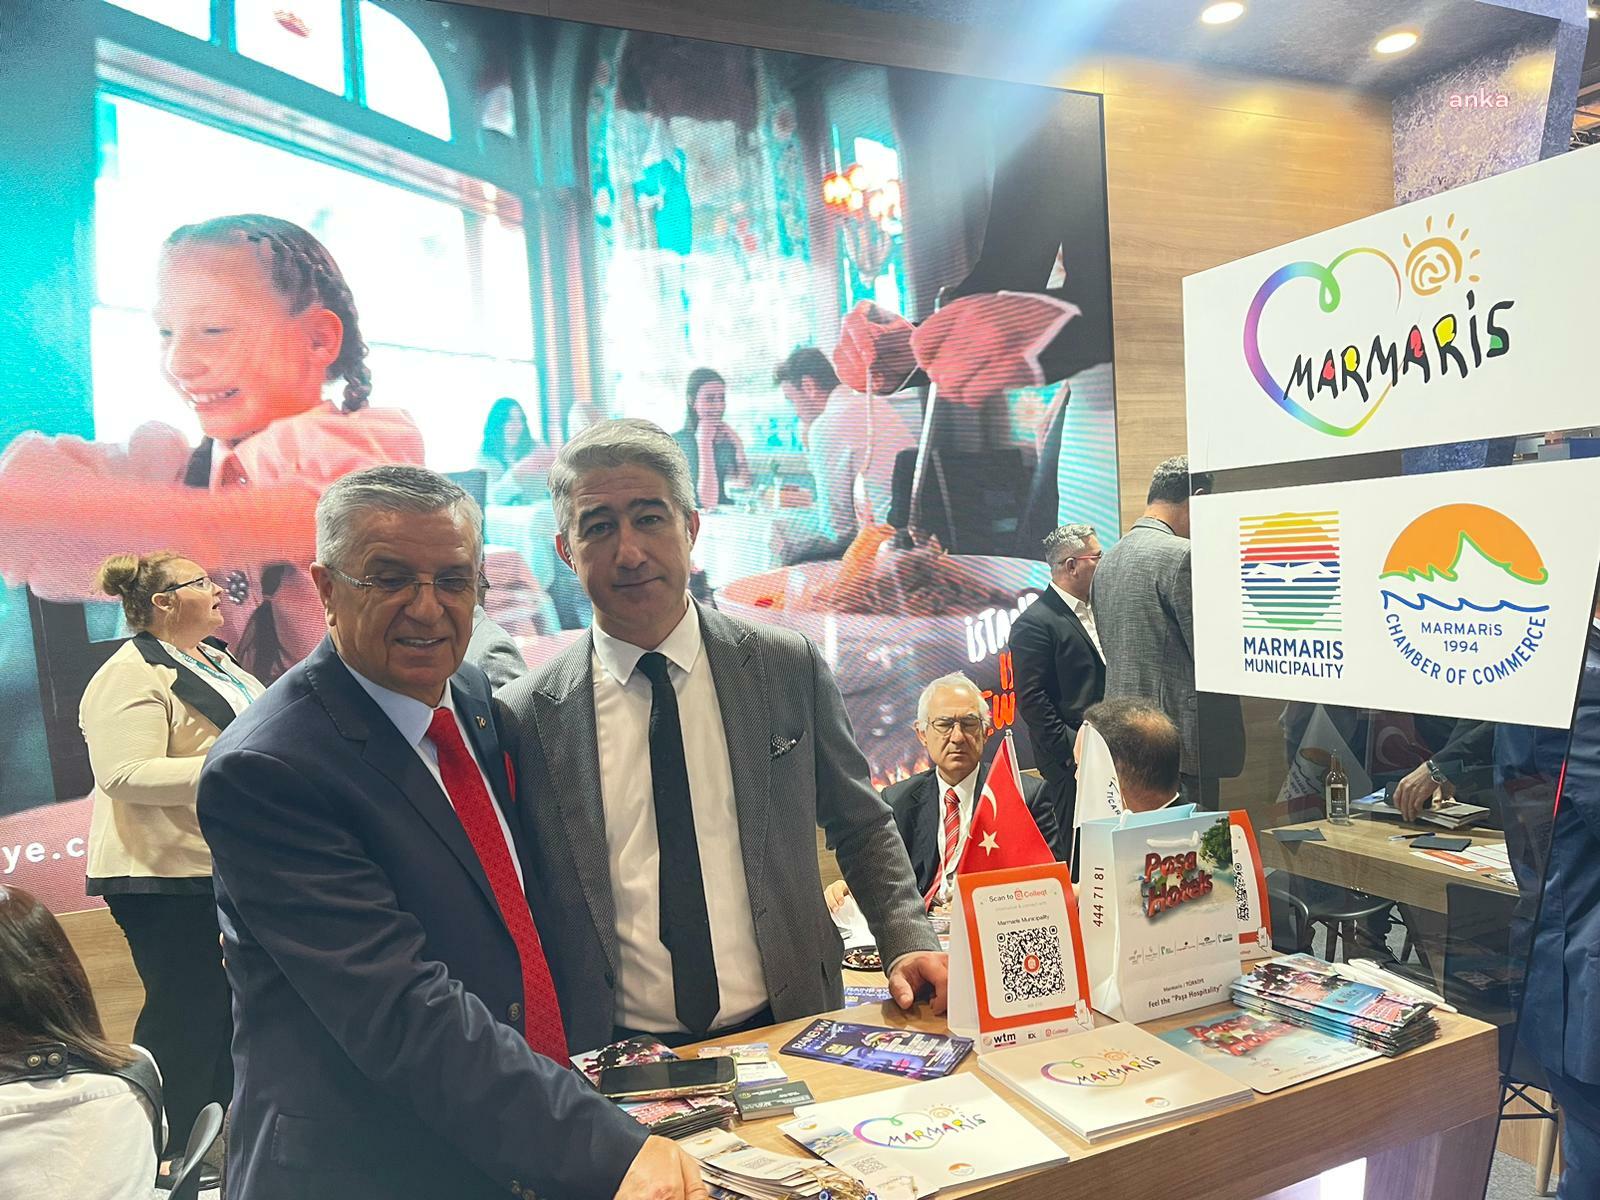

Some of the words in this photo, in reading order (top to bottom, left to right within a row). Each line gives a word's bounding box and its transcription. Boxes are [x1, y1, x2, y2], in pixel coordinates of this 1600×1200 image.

[1243, 636, 1344, 660] MARMARIS
[1386, 613, 1441, 680] CHAMBER
[1446, 667, 1467, 685] OF
[1472, 616, 1546, 685] COMMERCE
[1443, 640, 1479, 653] 1994
[1244, 658, 1344, 679] MUNICIPALITY
[1094, 867, 1105, 880] 81
[989, 894, 1006, 903] Scan
[1093, 887, 1104, 900] 71
[1093, 904, 1104, 928] 444
[1161, 998, 1171, 1006] the
[993, 1032, 1016, 1044] wtm
